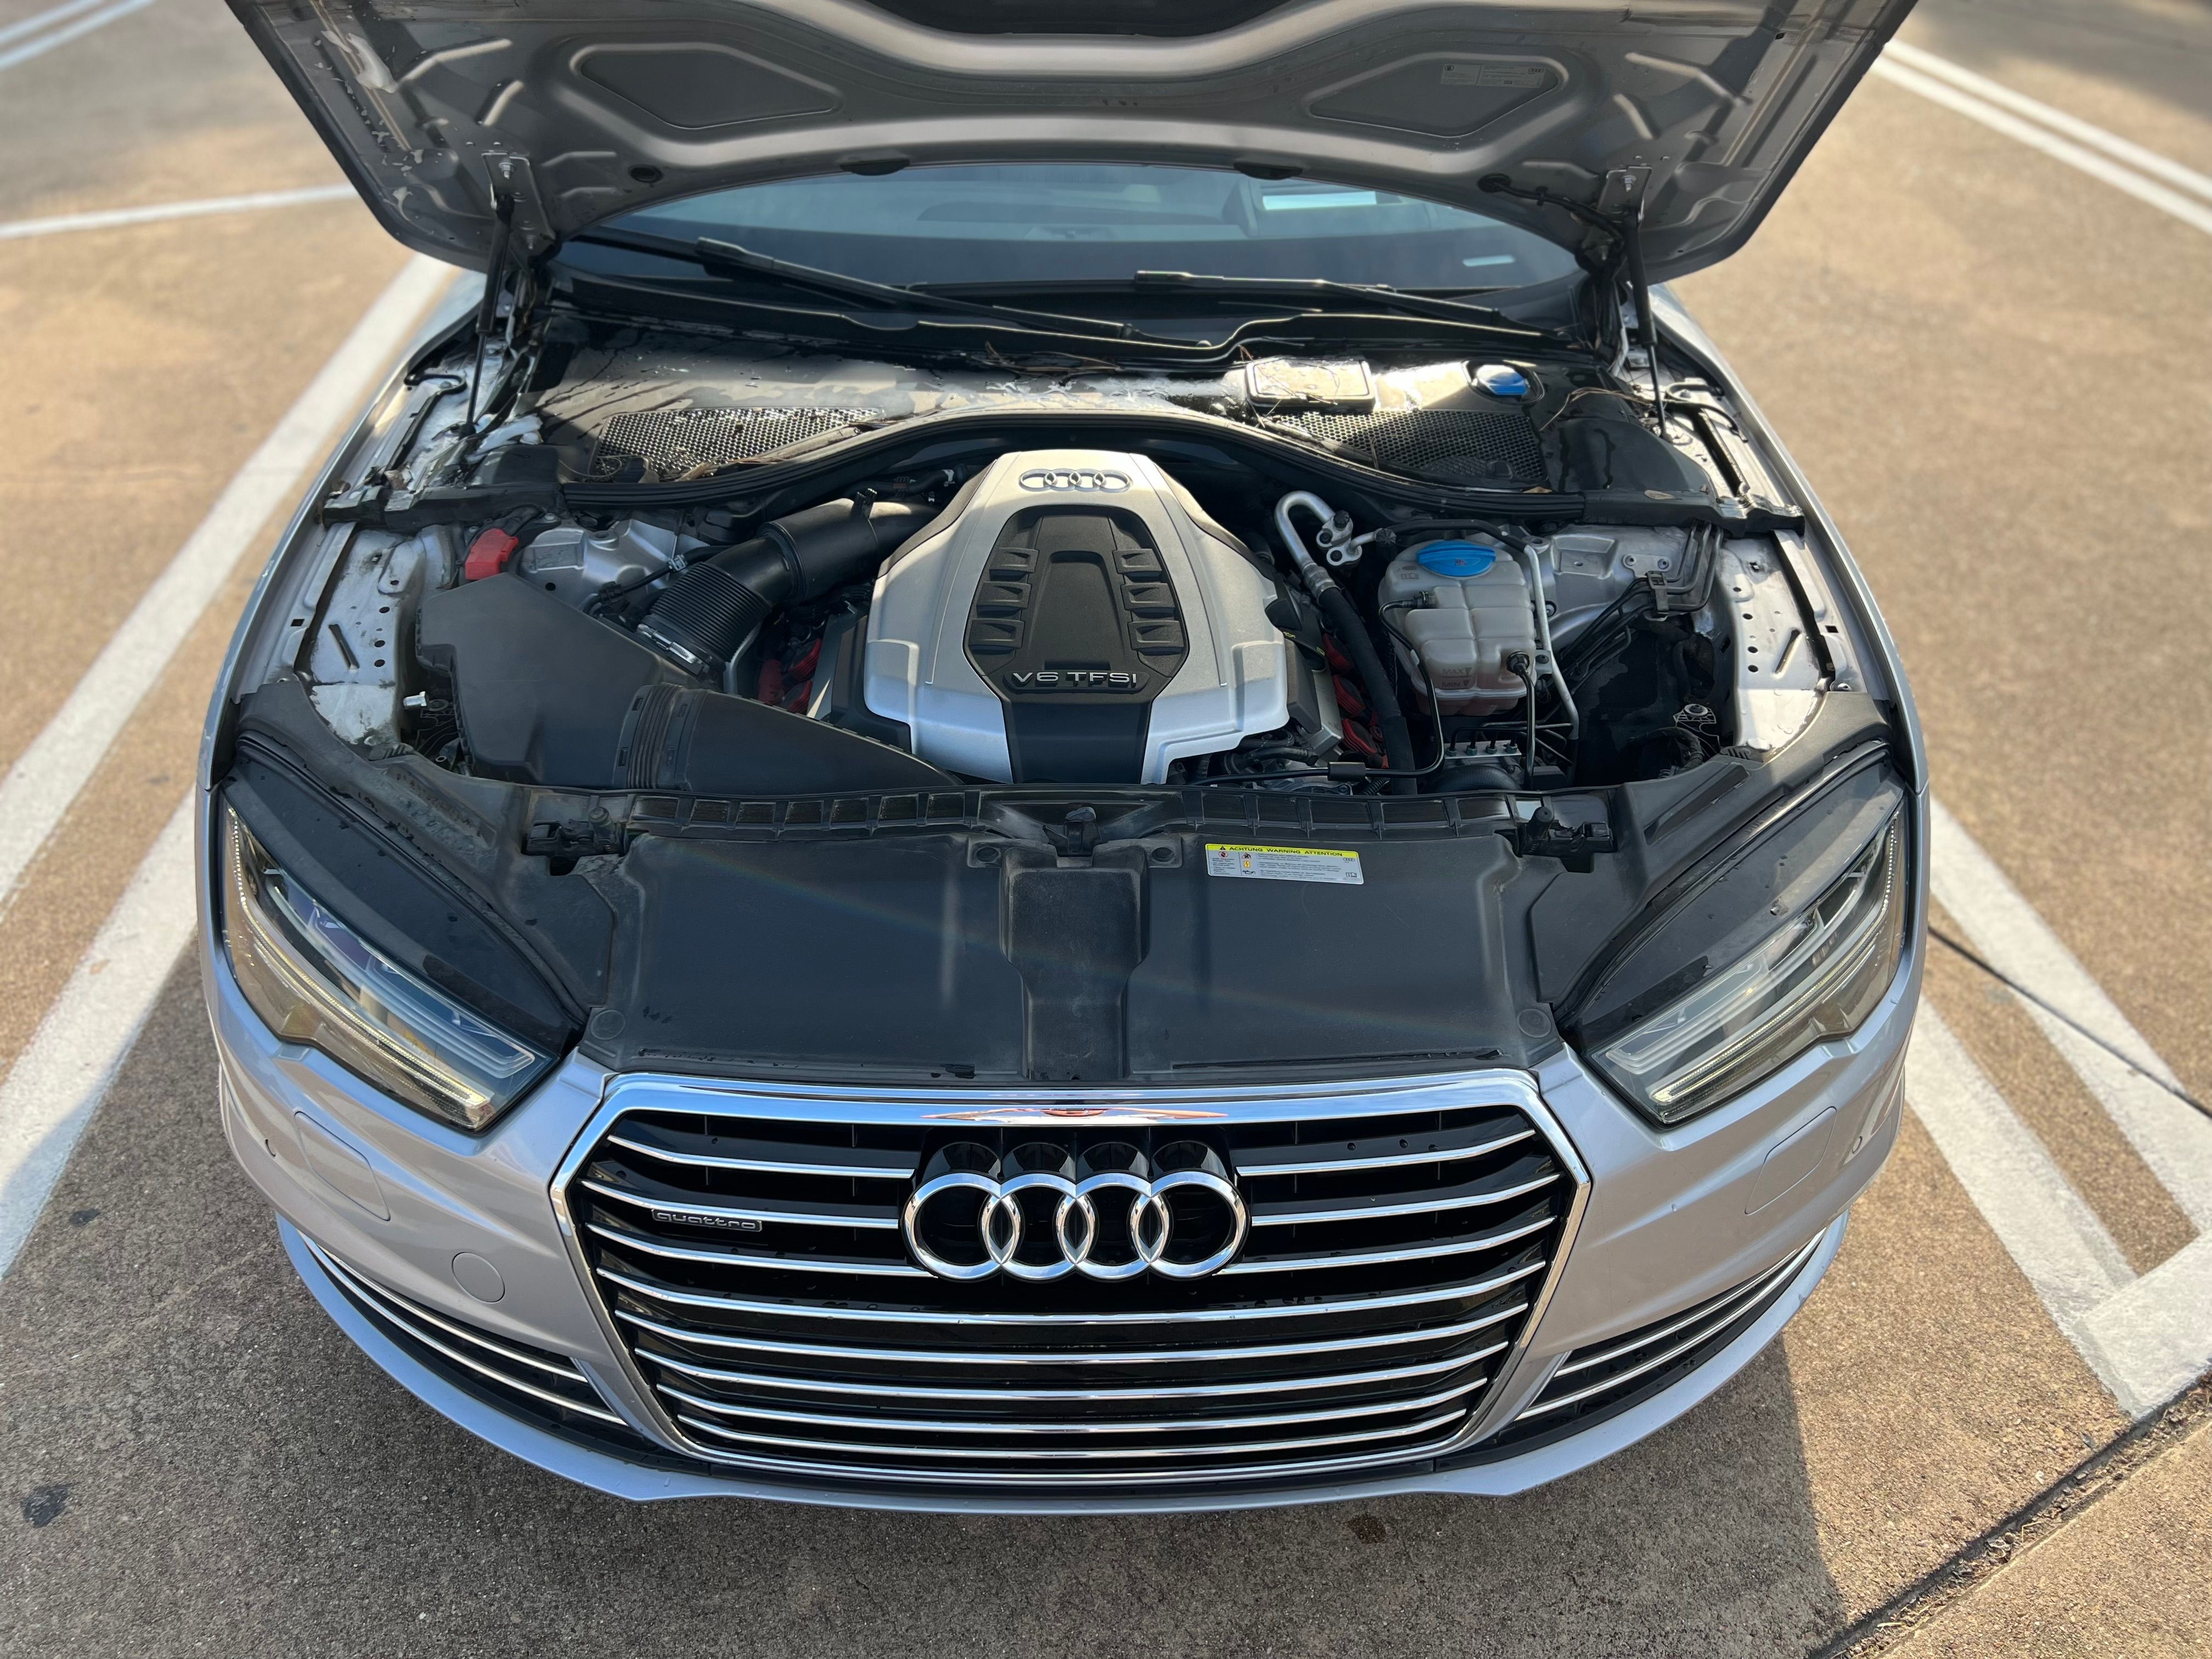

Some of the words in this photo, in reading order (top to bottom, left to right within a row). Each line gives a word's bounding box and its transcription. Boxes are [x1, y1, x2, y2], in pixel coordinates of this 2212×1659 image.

[1013, 672, 1059, 682] V6
[1067, 672, 1137, 684] TFSI
[657, 1212, 756, 1229] quattro
